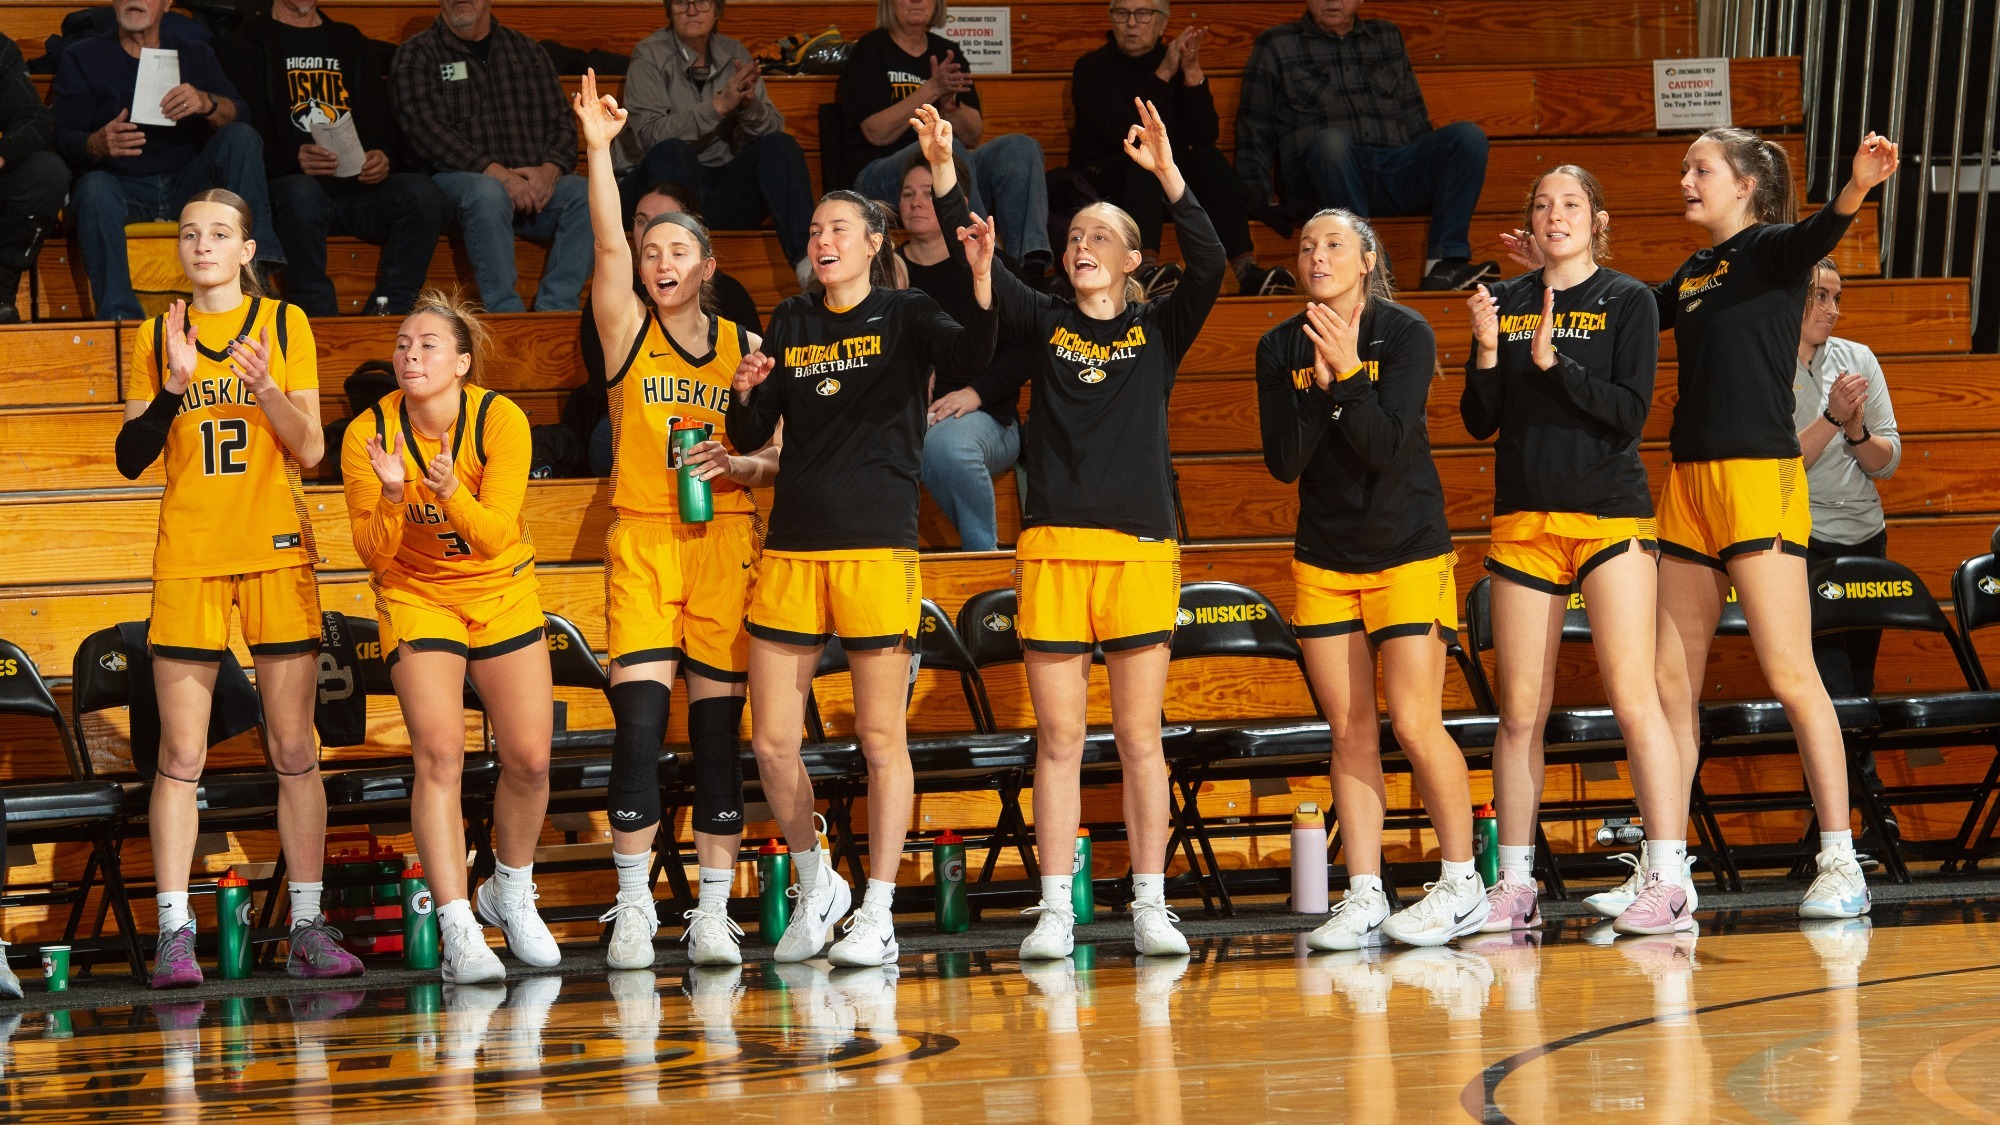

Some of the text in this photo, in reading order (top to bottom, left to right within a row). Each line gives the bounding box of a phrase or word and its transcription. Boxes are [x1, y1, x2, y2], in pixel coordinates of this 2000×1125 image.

[946, 28, 994, 37] CAUTION!
[286, 57, 341, 70] HIGAN TE
[1668, 80, 1713, 90] CAUTION!
[1704, 90, 1723, 98] Stand
[1674, 101, 1687, 109] Top
[1500, 311, 1607, 333] MICHIN TECH
[1508, 327, 1591, 341] BASTBALL
[842, 336, 881, 358] TECH
[795, 357, 868, 378] BASKETBALL
[176, 376, 258, 417] USKIE
[642, 376, 731, 416] HUSKIE
[199, 418, 248, 477] 12
[436, 530, 473, 559] 3
[1845, 580, 1913, 599] HUSKIES
[1196, 604, 1267, 624] HUSKIES
[943, 860, 962, 882] G
[412, 891, 432, 915] G
